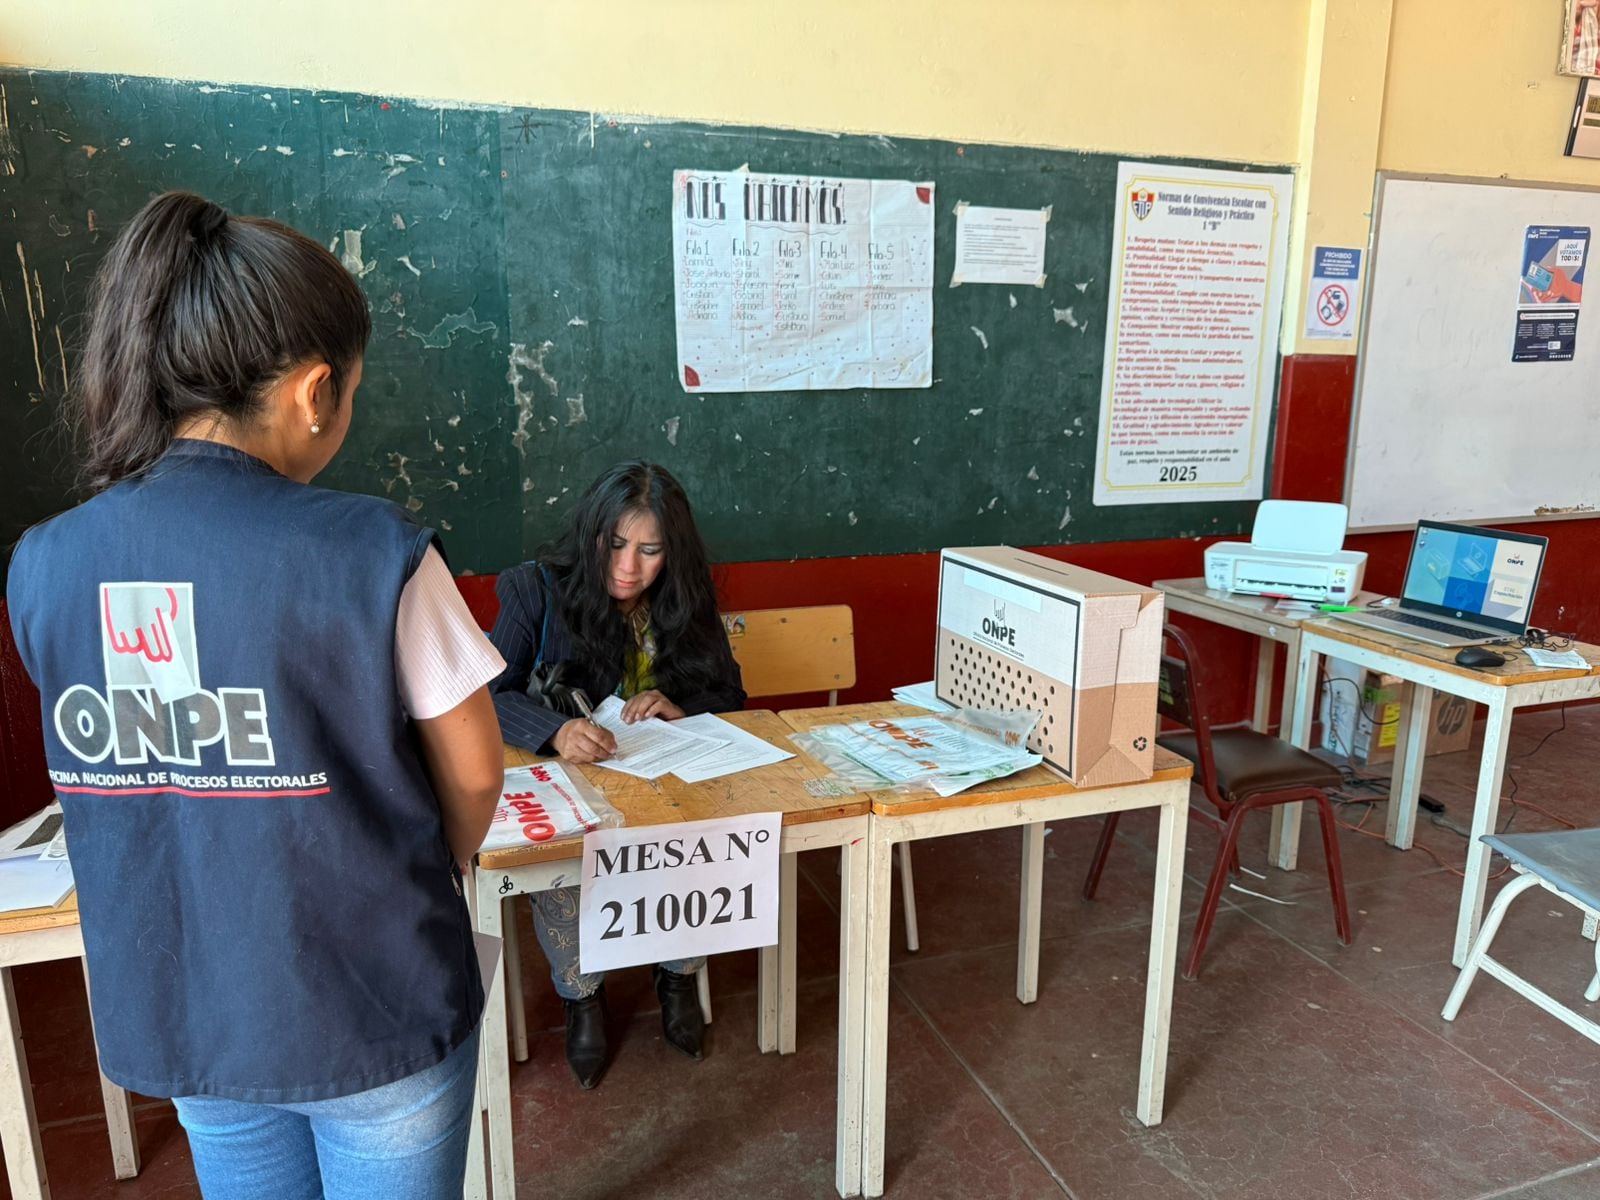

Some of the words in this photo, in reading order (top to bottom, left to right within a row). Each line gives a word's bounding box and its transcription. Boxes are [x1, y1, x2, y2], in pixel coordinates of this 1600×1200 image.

[683, 181, 727, 220] NOS
[1157, 193, 1182, 203] Normas
[1183, 194, 1191, 204] de
[1192, 195, 1230, 206] Convivencia
[1231, 197, 1253, 208] Escolar
[1167, 205, 1192, 216] Sentido
[1192, 207, 1222, 219] Religioso
[1223, 211, 1227, 220] y
[1228, 209, 1254, 219] Práctico
[1159, 466, 1196, 482] 2025
[982, 617, 1016, 646] ONPE
[55, 684, 275, 766] ONPE
[1440, 700, 1466, 735] hp
[82, 771, 145, 786] NACIONAL
[148, 772, 168, 784] DE
[170, 772, 227, 788] PROCESOS
[232, 772, 328, 788] ELECTORALES
[529, 765, 552, 782] ONPE
[503, 791, 556, 842] ONPE
[592, 836, 714, 878] MESA
[726, 829, 770, 861] N°
[599, 882, 758, 941] 210021
